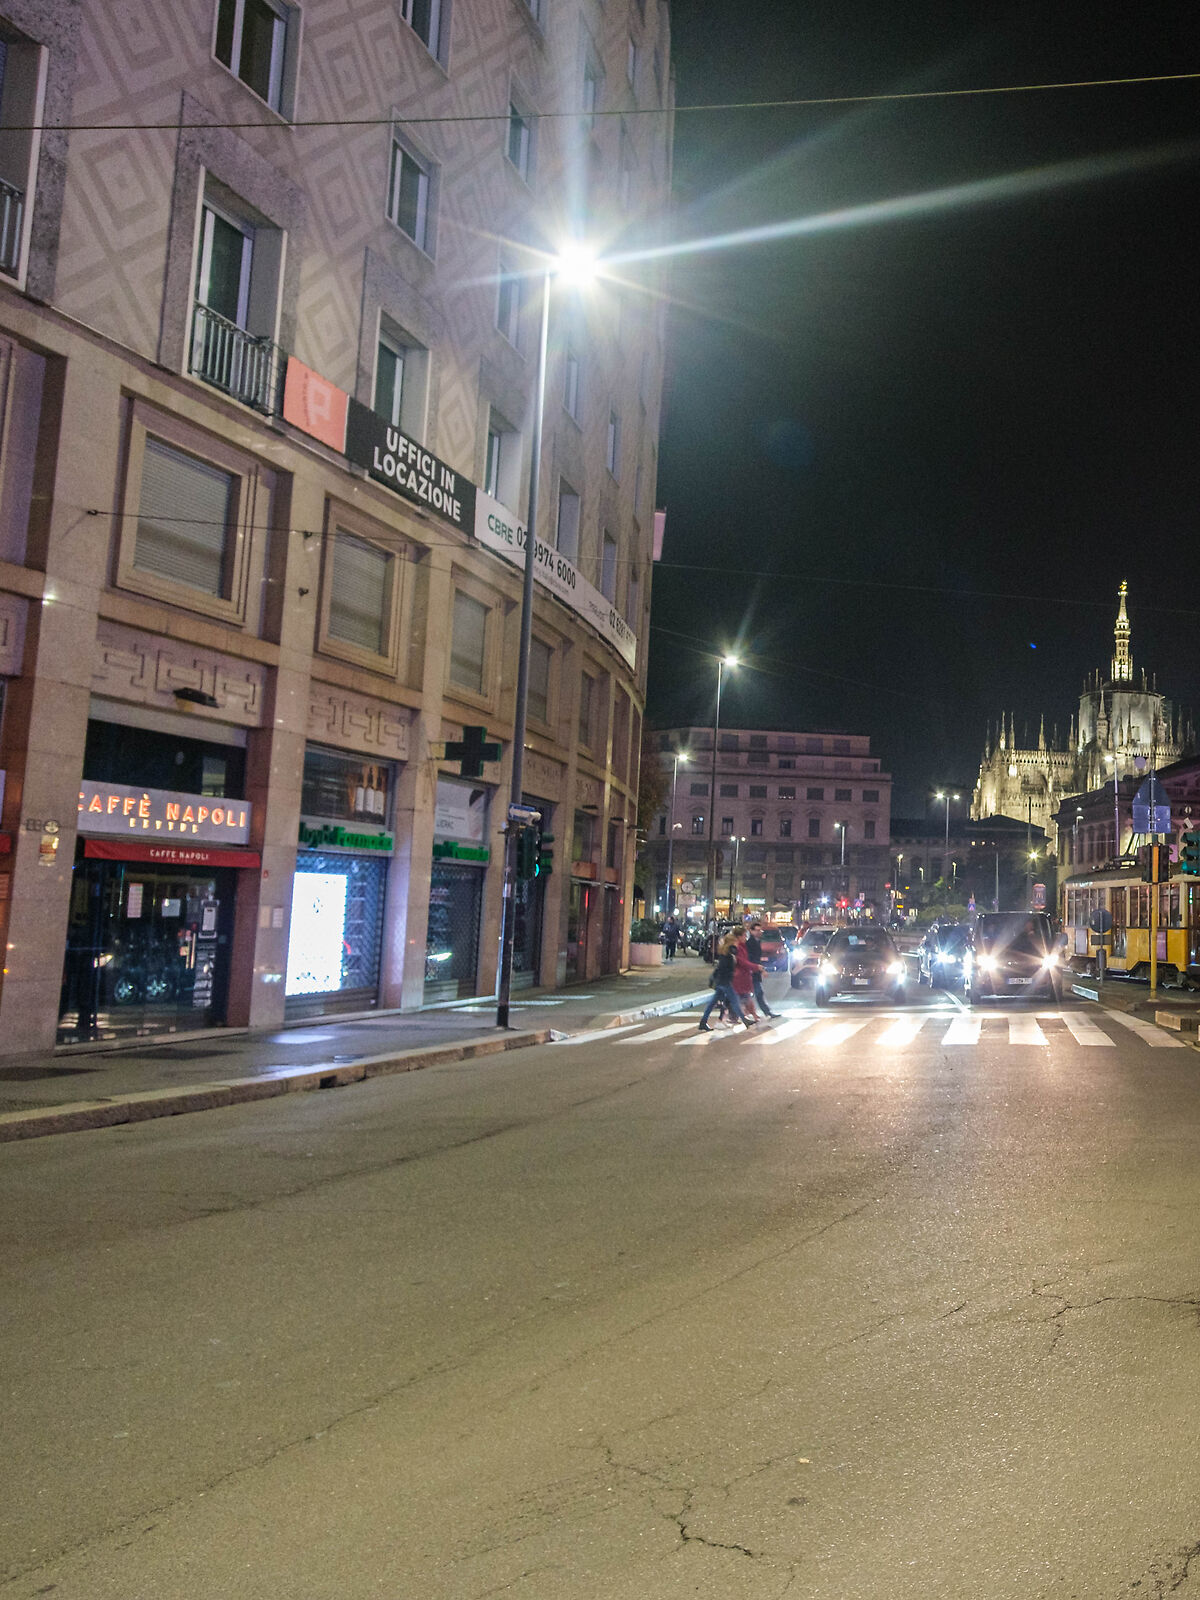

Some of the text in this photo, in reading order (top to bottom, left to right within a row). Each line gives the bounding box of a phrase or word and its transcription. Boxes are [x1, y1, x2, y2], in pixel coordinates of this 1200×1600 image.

[373, 446, 462, 522] LOCAZIONE
[386, 427, 456, 494] UFFICI IN
[487, 514, 514, 545] CBRE
[557, 558, 576, 590] 6000
[166, 802, 246, 828] NAPOLI
[178, 851, 209, 861] NAPOLI
